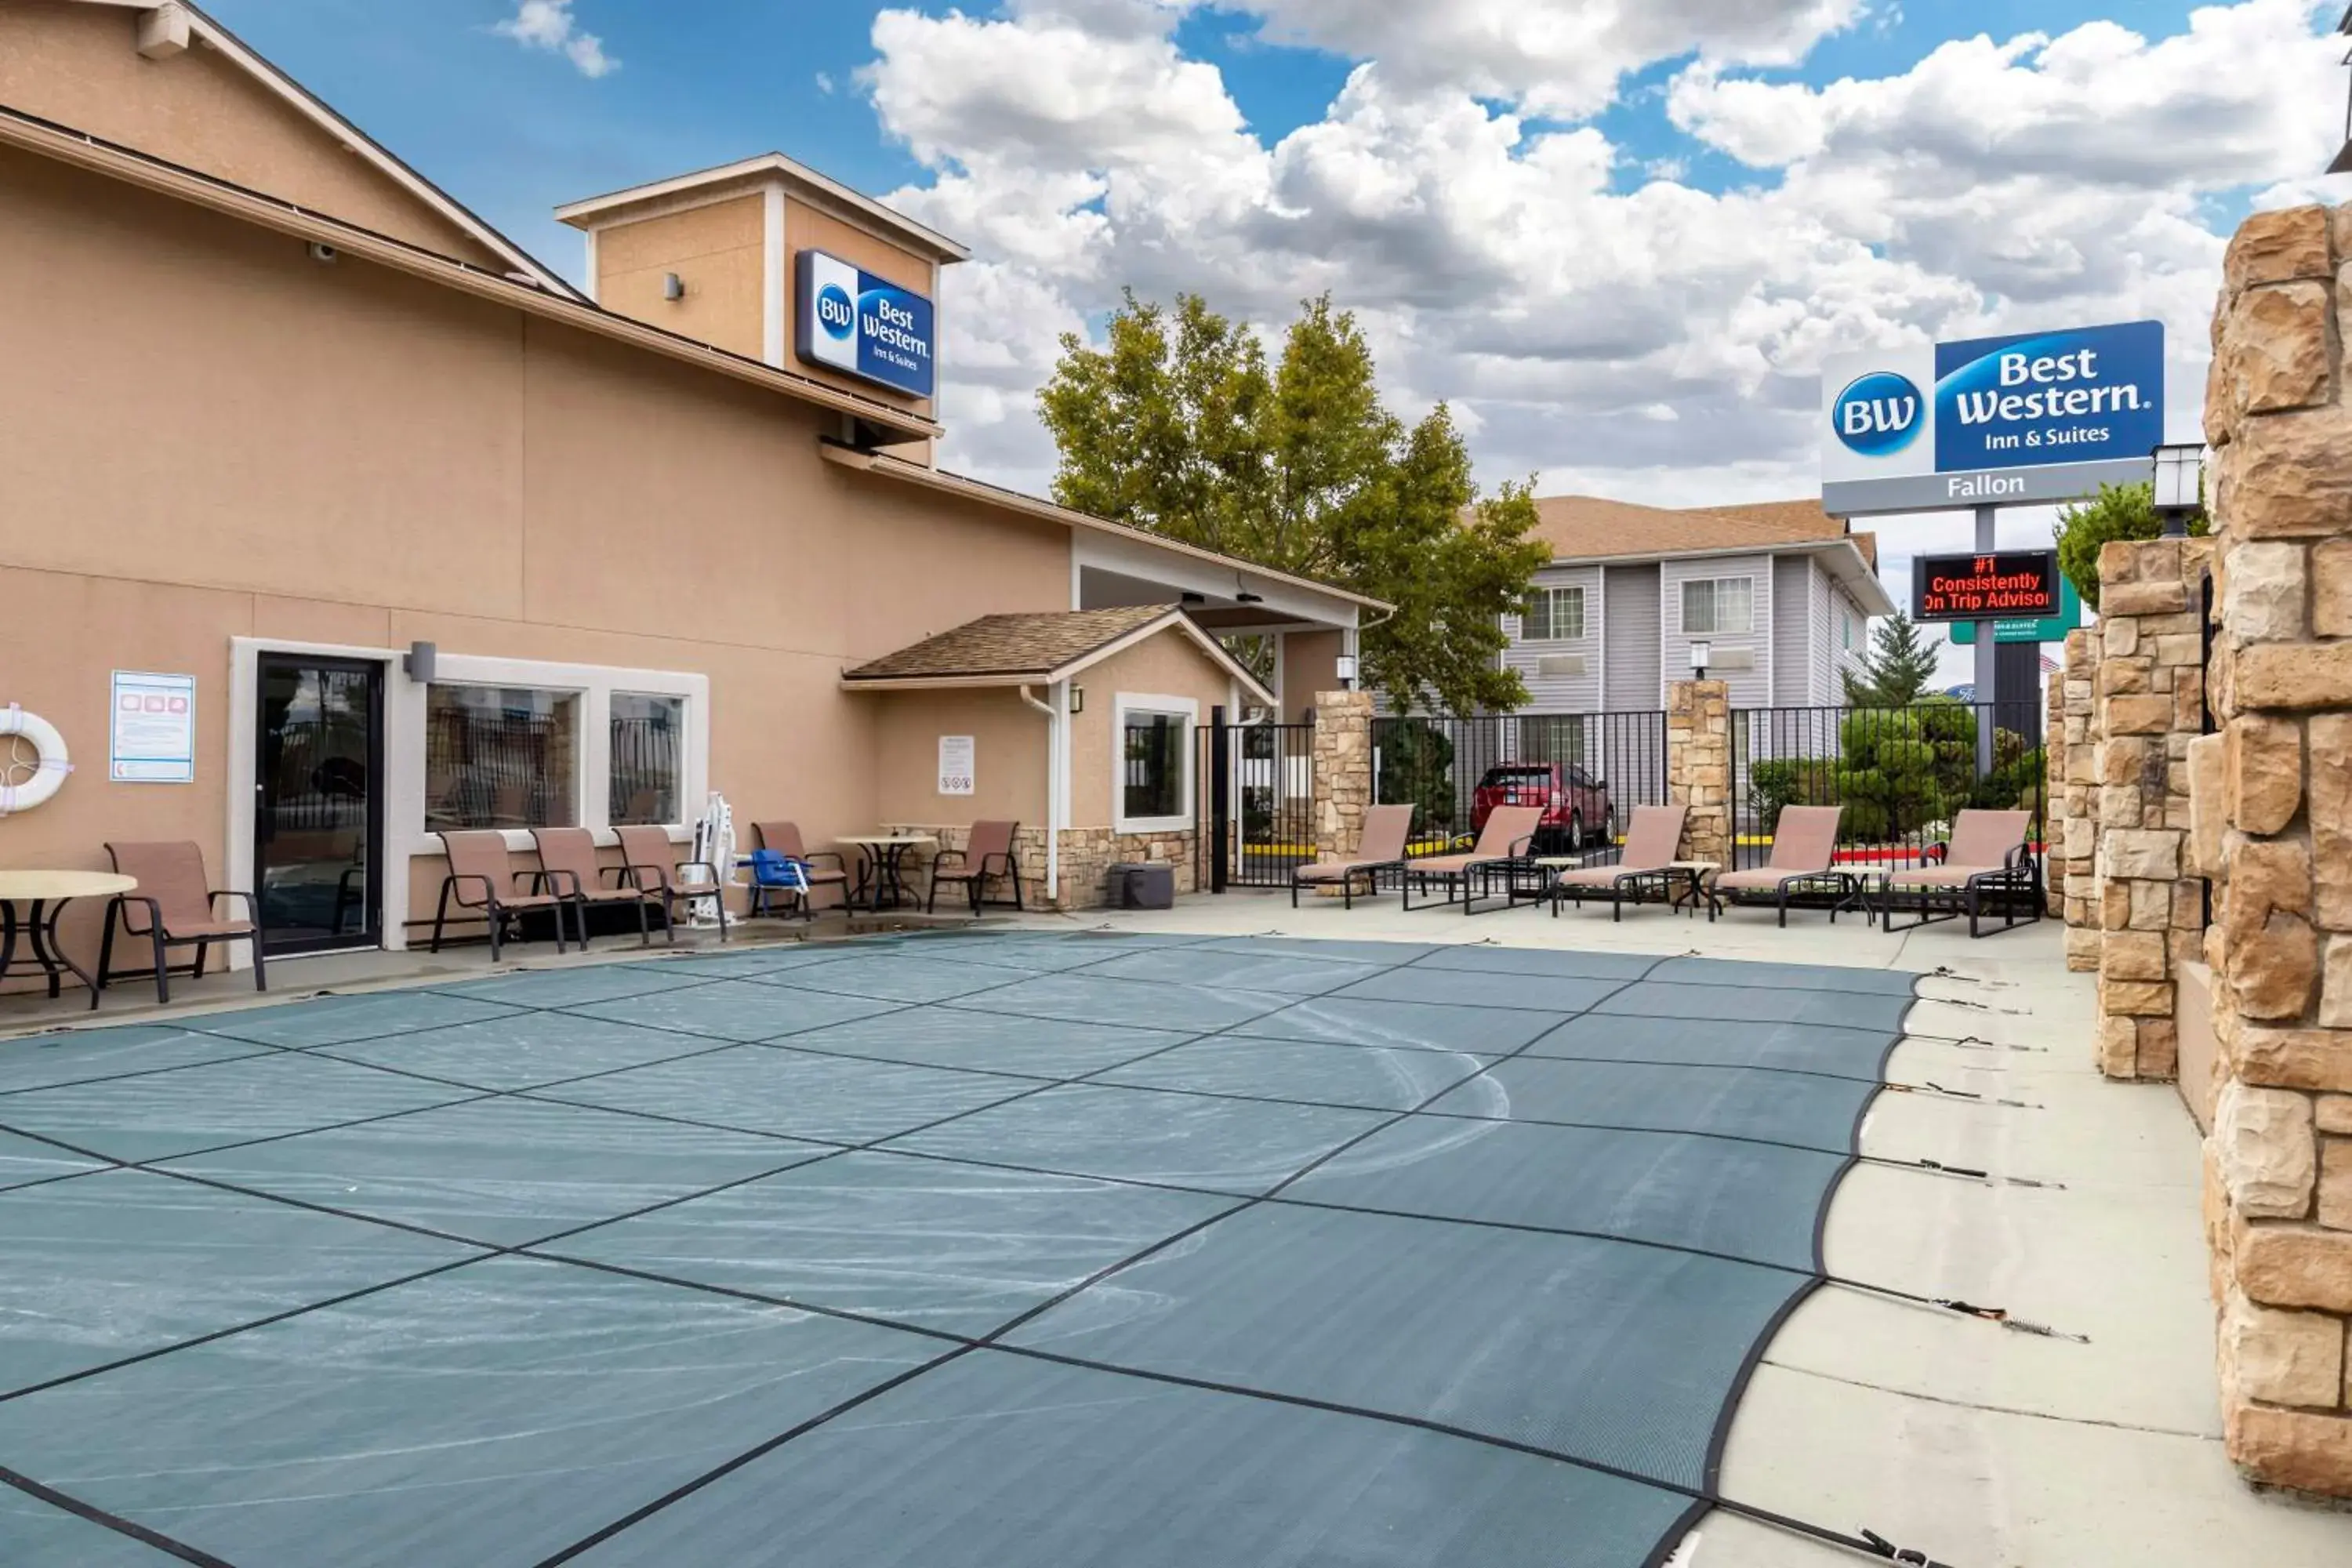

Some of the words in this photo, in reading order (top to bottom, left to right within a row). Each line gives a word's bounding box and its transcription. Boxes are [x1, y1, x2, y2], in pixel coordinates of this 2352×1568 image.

[821, 298, 851, 326] BW
[879, 298, 913, 331] Best
[863, 313, 927, 358] Western
[2000, 349, 2098, 387] Best
[1844, 395, 1915, 435] BW
[1956, 383, 2140, 424] Western
[1986, 434, 2020, 450] Inn
[2025, 430, 2042, 447] &
[2046, 426, 2110, 445] Suites
[1947, 474, 2025, 498] Fallon
[1974, 557, 1994, 573] #1
[1933, 573, 2040, 593] Consistently
[1948, 593, 1982, 610] Trip
